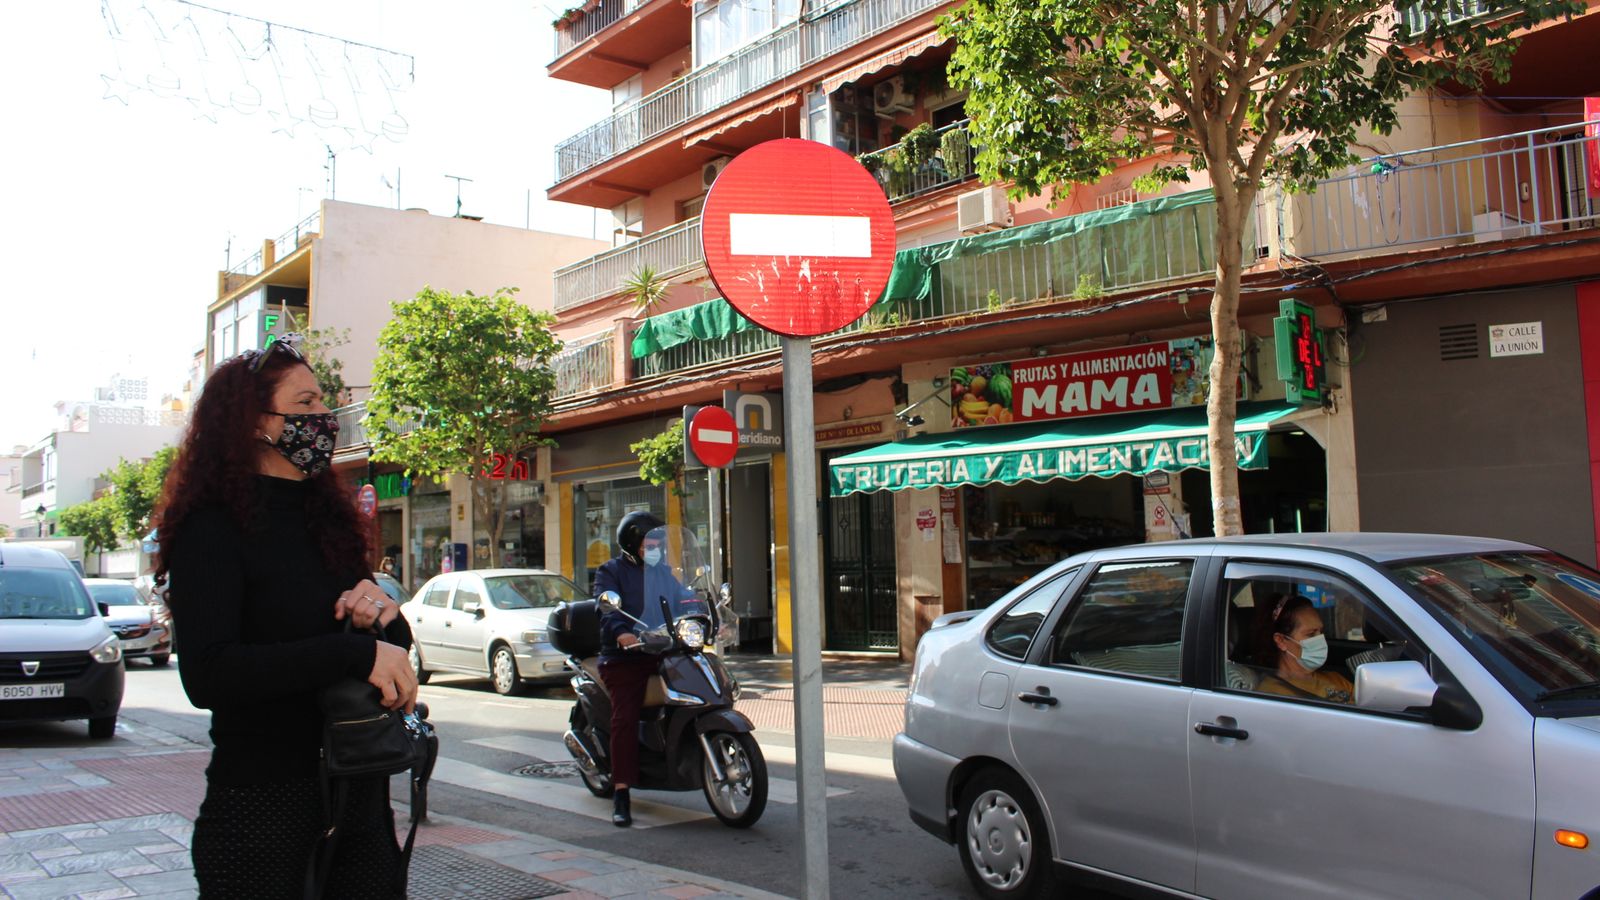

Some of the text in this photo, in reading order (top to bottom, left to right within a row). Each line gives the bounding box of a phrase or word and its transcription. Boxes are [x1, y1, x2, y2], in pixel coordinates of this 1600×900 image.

[1508, 325, 1537, 337] CALLE
[1494, 340, 1539, 353] LA UNIÓN
[1013, 348, 1167, 384] FRUTAS Y ALIMENTACIÓN
[1021, 373, 1162, 417] MAMA
[837, 436, 1252, 489] FRUTERIA Y ALIMENTACIN
[3, 684, 64, 698] 6050 HVV
